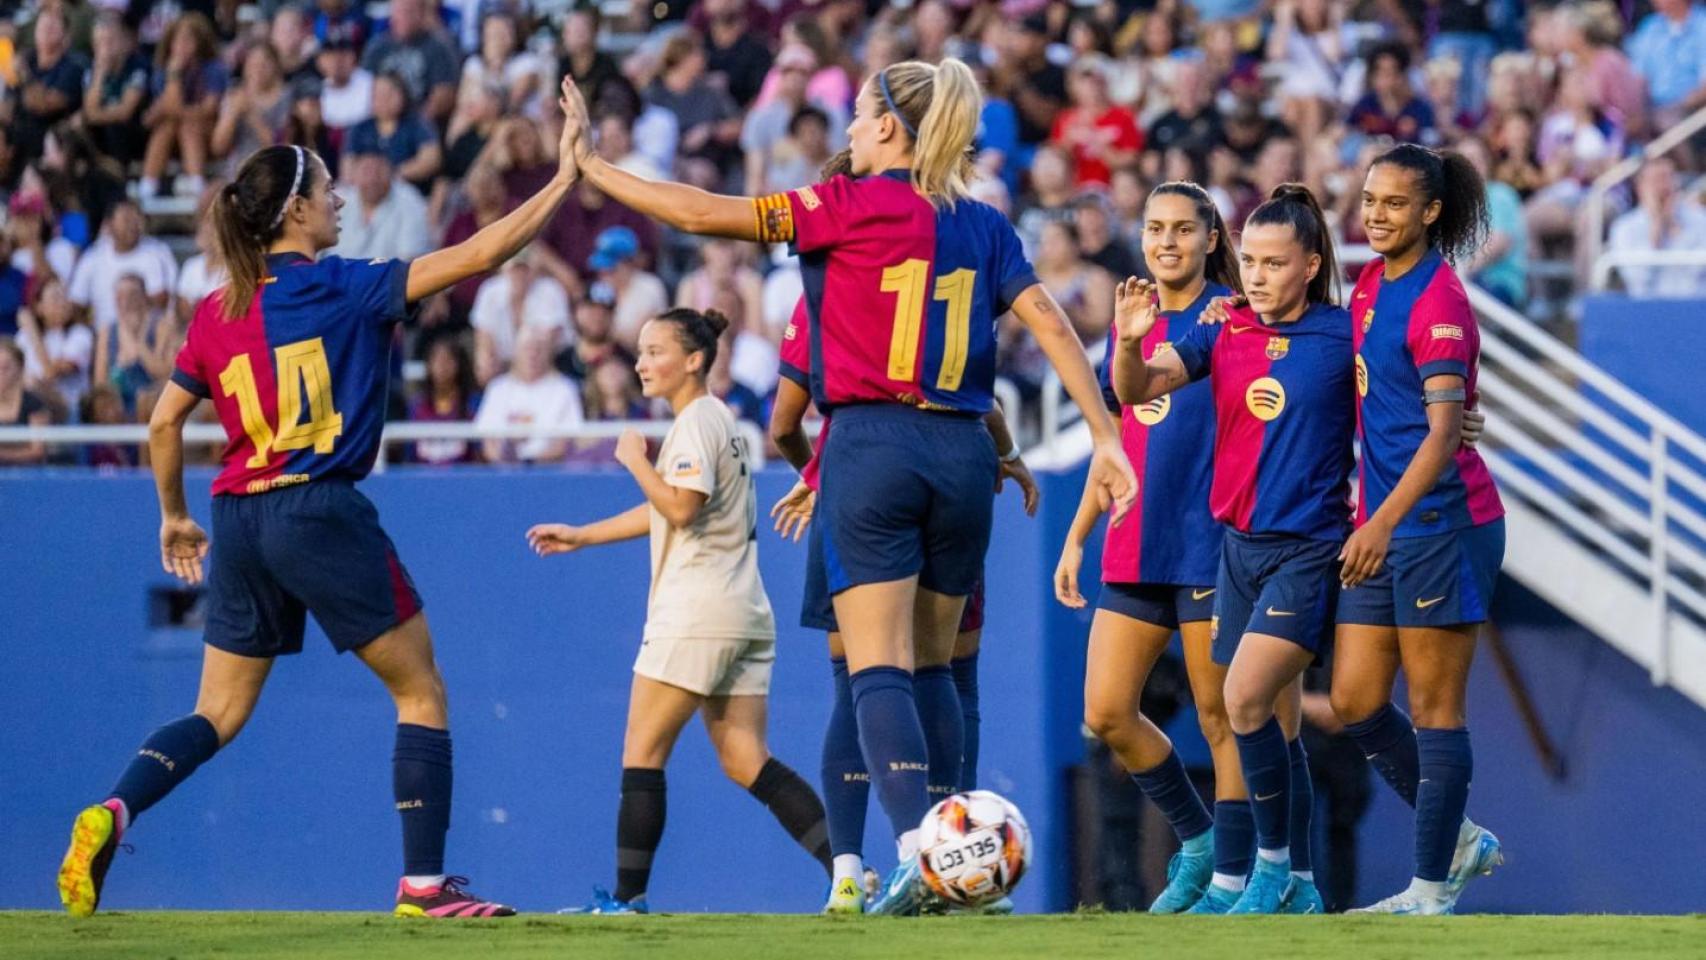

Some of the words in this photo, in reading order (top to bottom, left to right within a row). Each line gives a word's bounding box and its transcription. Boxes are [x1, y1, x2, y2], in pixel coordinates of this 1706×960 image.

[880, 257, 978, 393] 11
[218, 336, 343, 469] 14
[936, 836, 997, 872] SELECT
